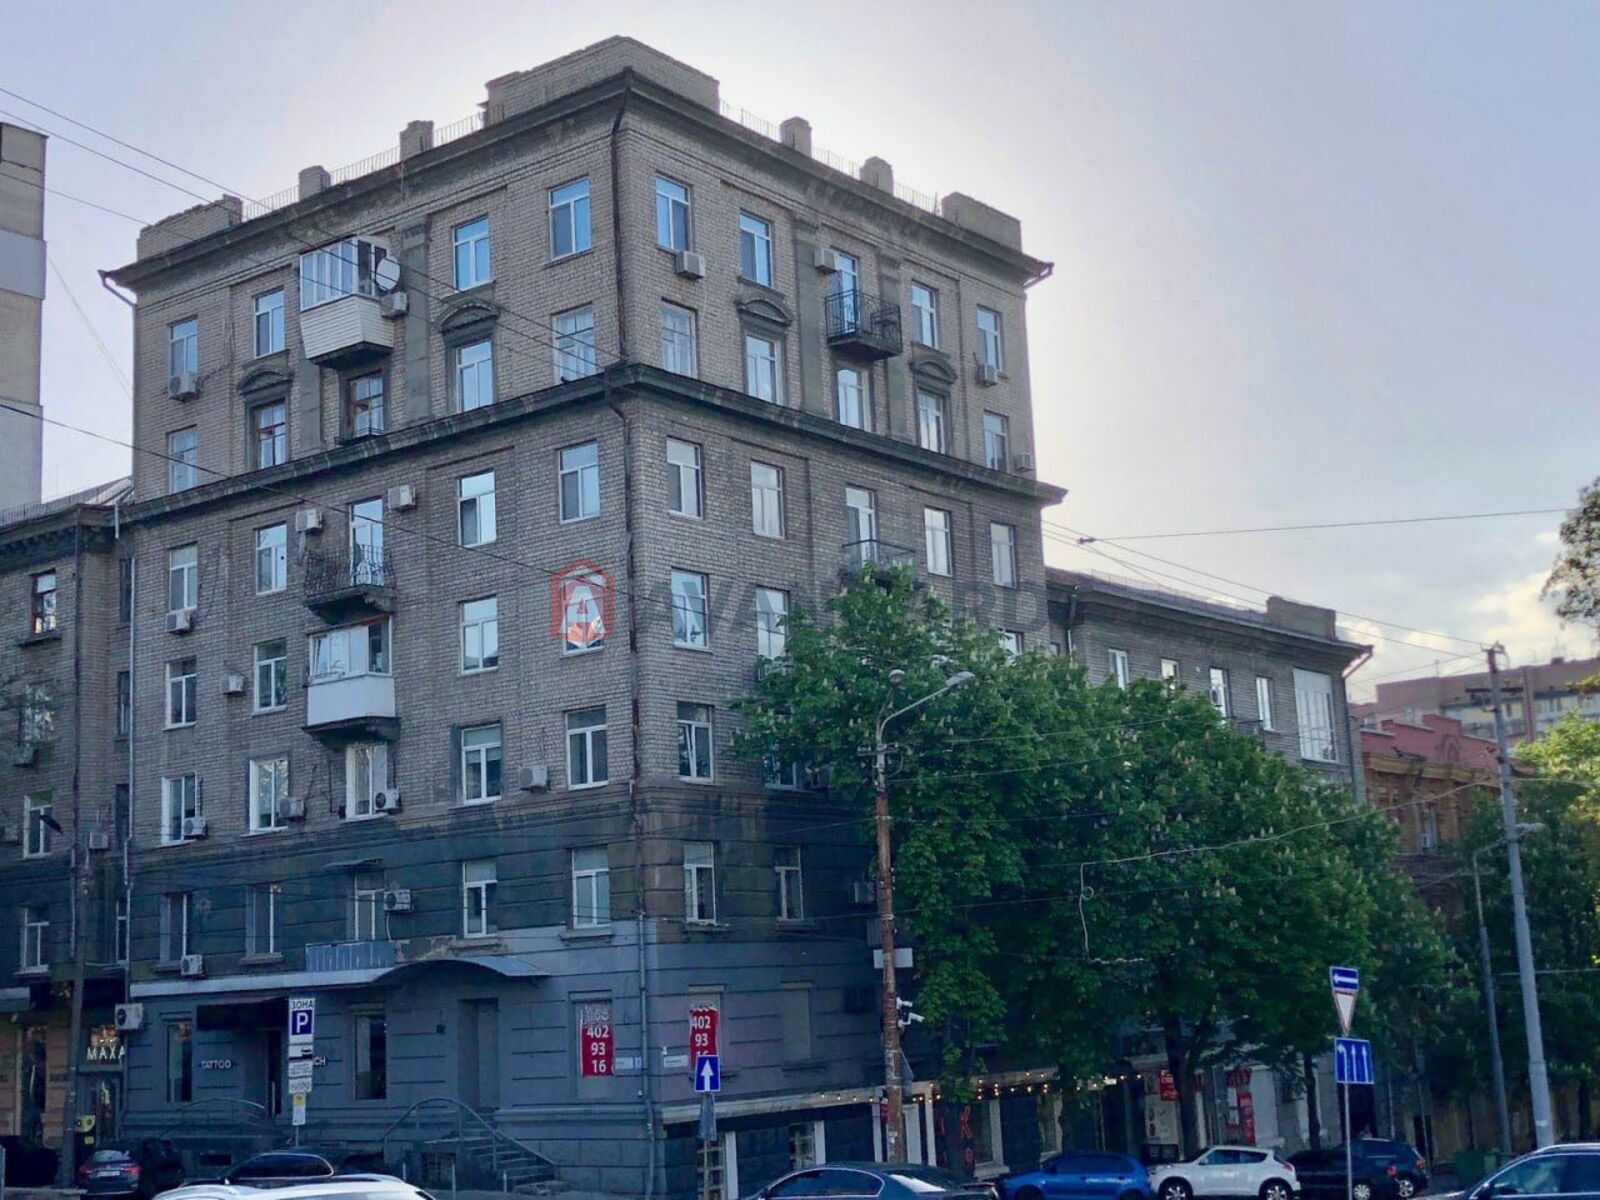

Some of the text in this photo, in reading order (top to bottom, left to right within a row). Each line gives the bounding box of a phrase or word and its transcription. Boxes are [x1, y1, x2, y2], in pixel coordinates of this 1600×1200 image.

[296, 1012, 309, 1034] P
[692, 1015, 711, 1029] 402
[586, 1025, 610, 1038] 402
[695, 1033, 709, 1047] 93
[590, 1042, 606, 1056] 93
[201, 1060, 231, 1069] TATTOO
[592, 1059, 606, 1073] 16
